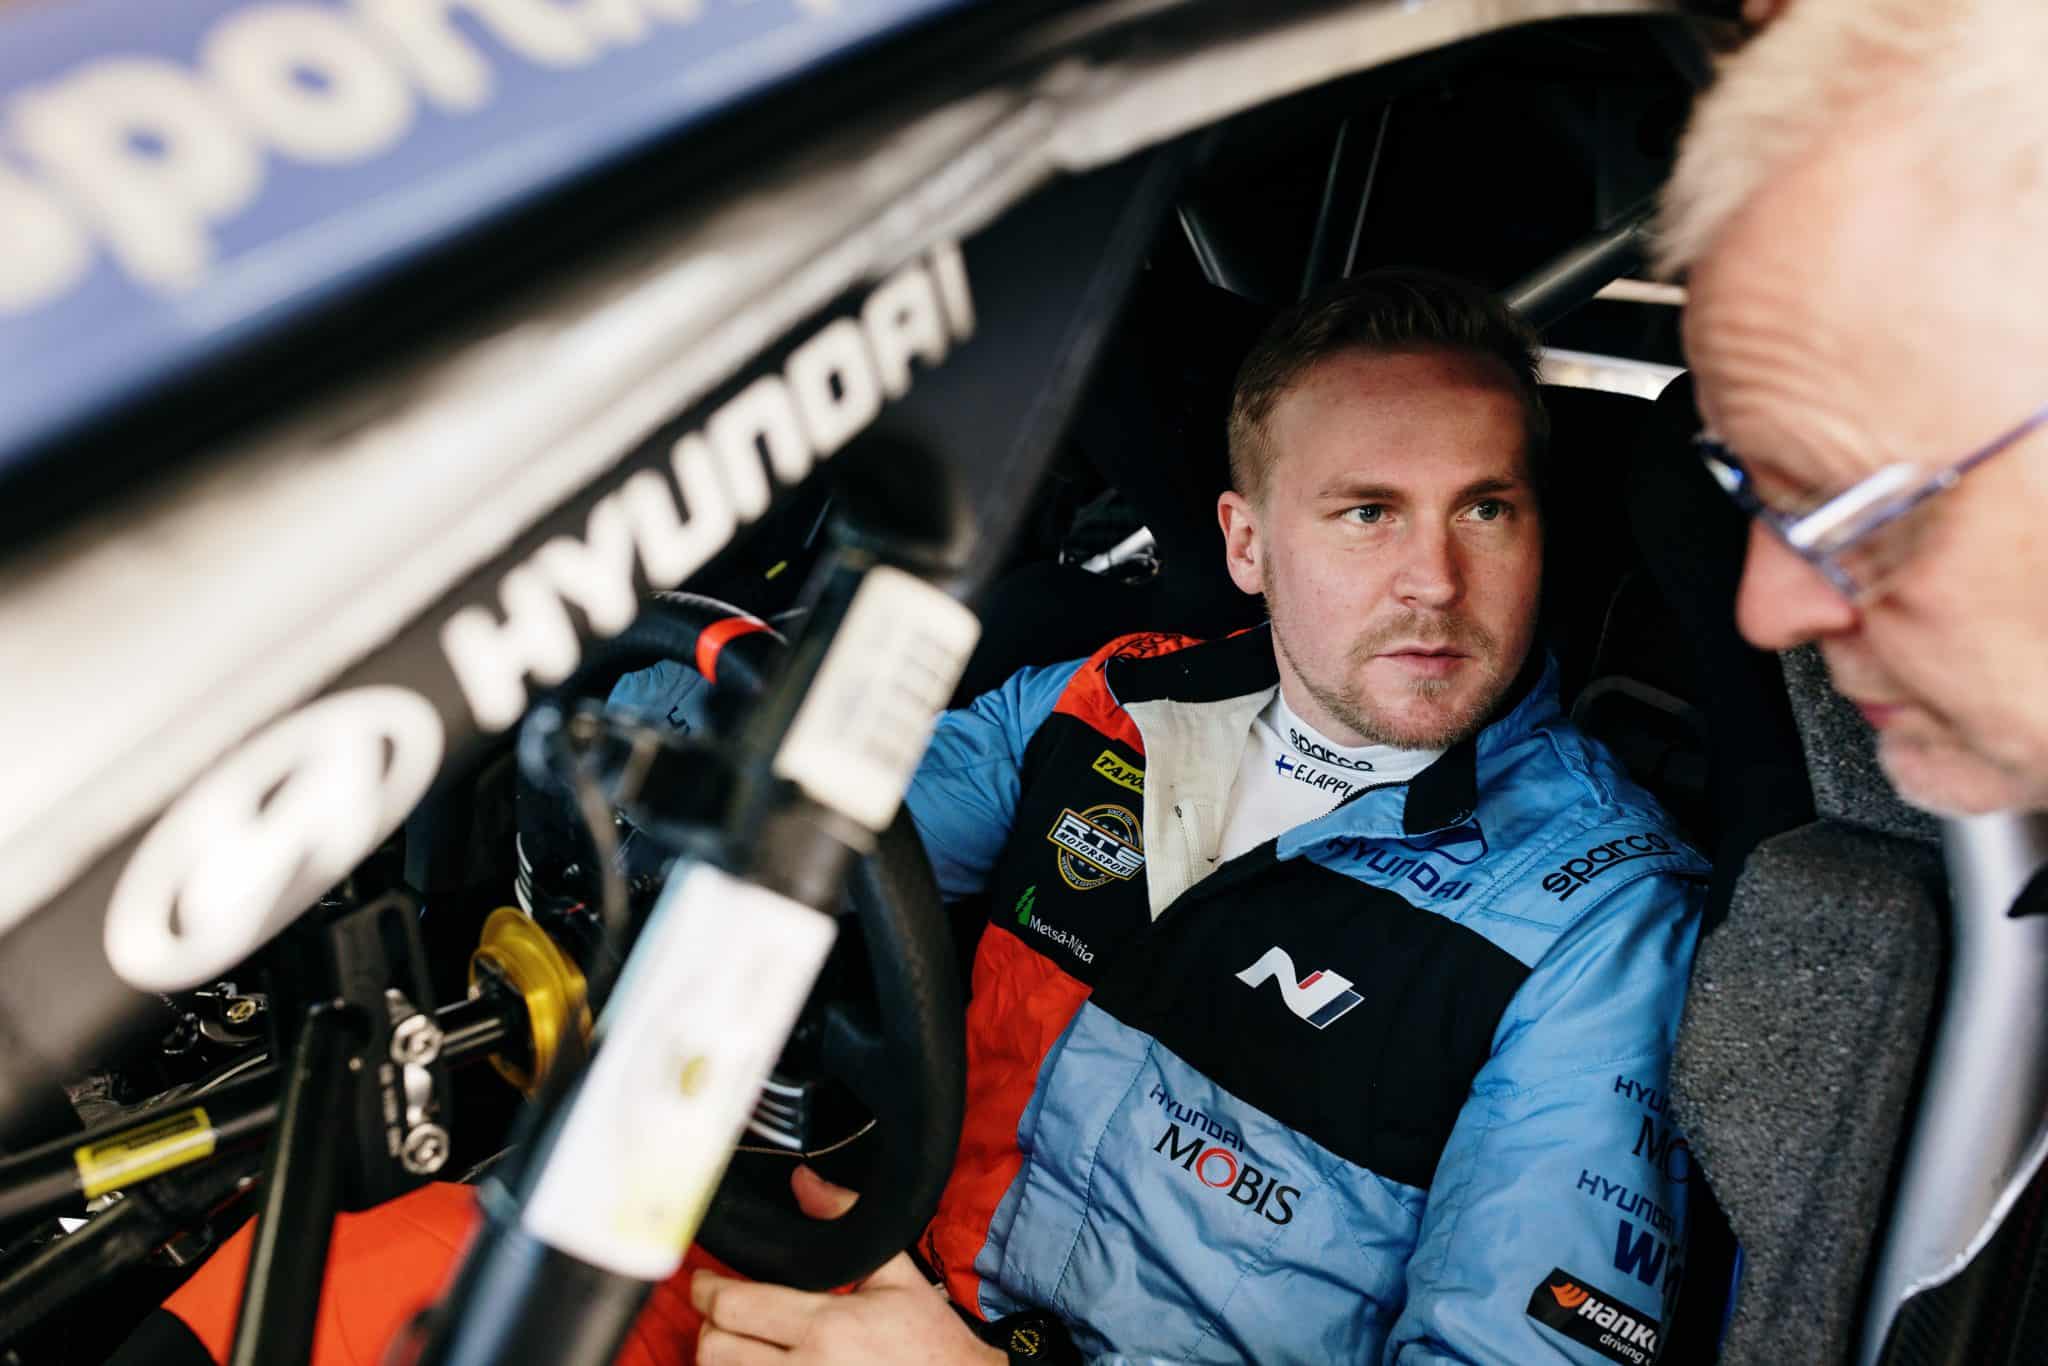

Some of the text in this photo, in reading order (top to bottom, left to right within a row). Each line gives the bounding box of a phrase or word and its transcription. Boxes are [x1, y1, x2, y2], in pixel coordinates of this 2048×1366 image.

[441, 240, 975, 733] HYUNDAI
[1096, 756, 1144, 789] TAPO
[1290, 728, 1376, 772] sparco
[1294, 764, 1353, 797] E.LAPPI
[1057, 832, 1132, 874] MOTORSPORT
[1326, 836, 1472, 900] HYUNDAI
[1542, 833, 1680, 900] sparco
[1150, 1084, 1244, 1152] HYUNDAI
[1153, 1123, 1301, 1225] MOBIS
[1600, 1334, 1644, 1364] driving
